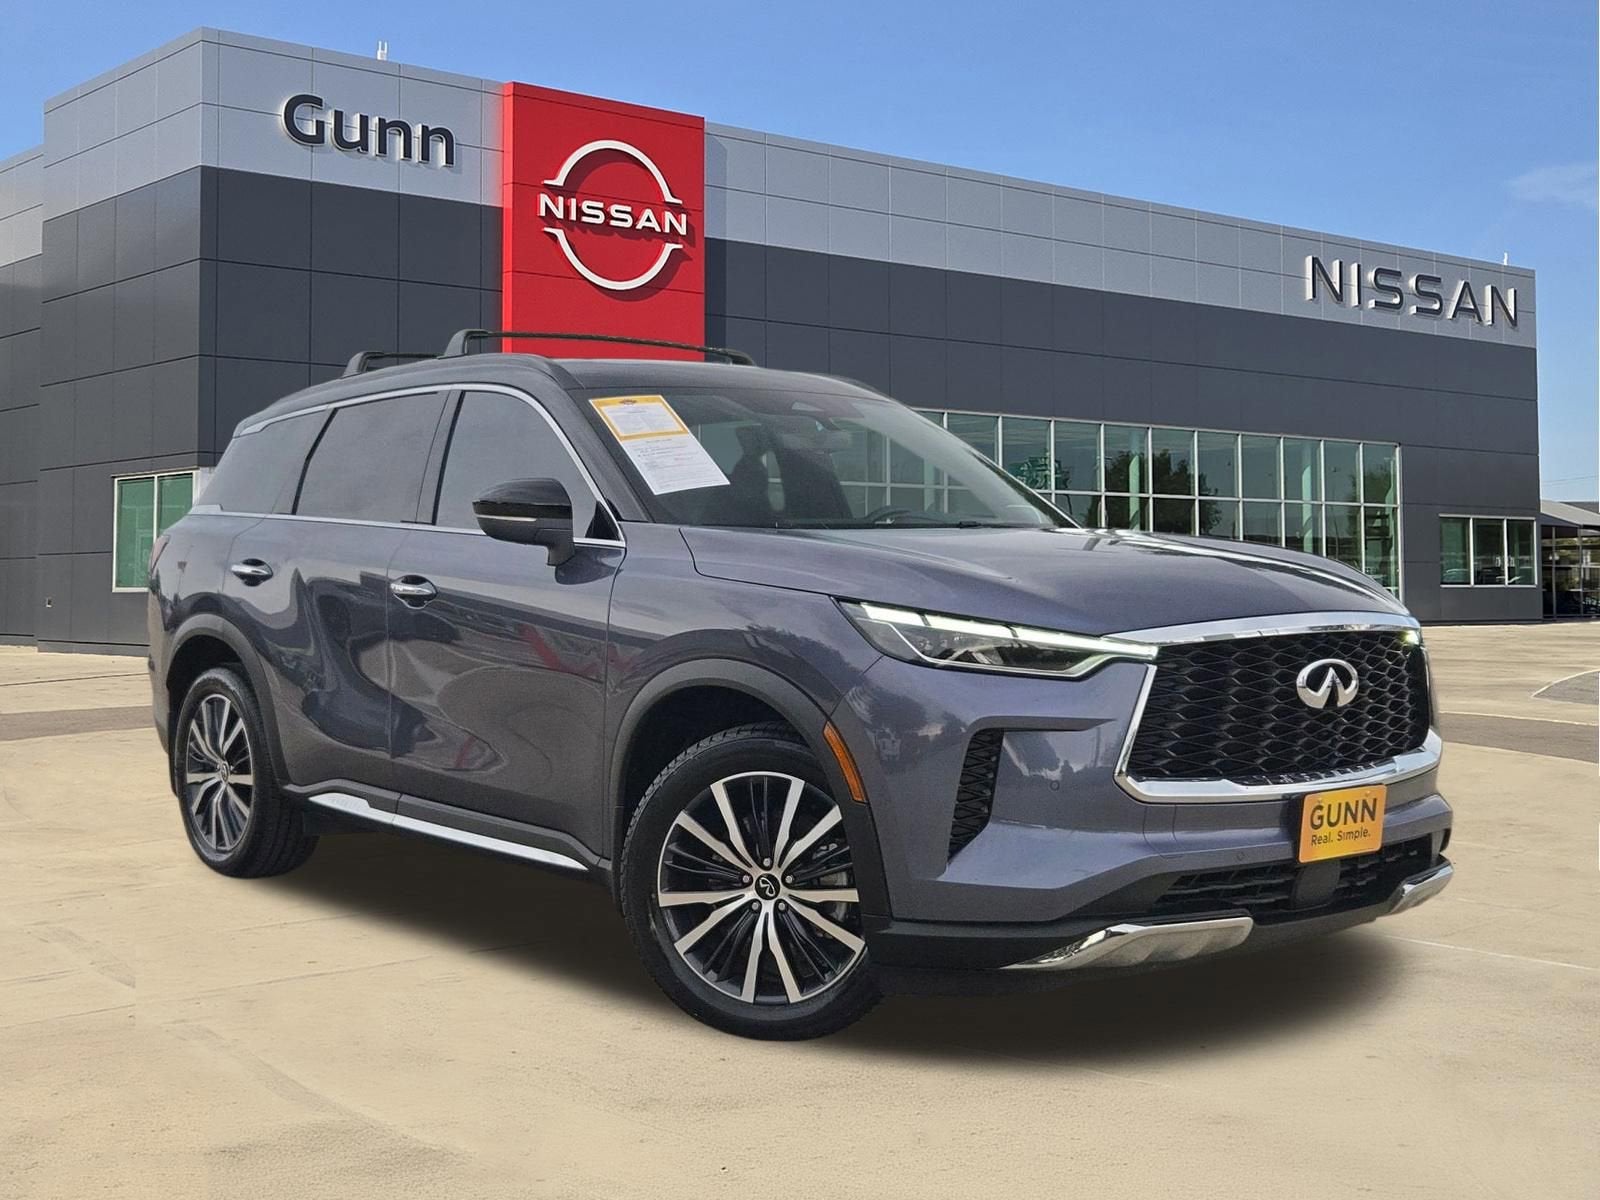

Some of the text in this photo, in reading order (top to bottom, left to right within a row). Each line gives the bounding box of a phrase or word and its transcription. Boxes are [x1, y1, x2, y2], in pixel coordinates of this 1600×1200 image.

[282, 93, 455, 167] Gunn
[537, 193, 688, 236] NISSAN
[1305, 255, 1518, 328] NISSAN
[1310, 798, 1377, 831] GUNN
[1311, 826, 1371, 847] Real. Simple.
